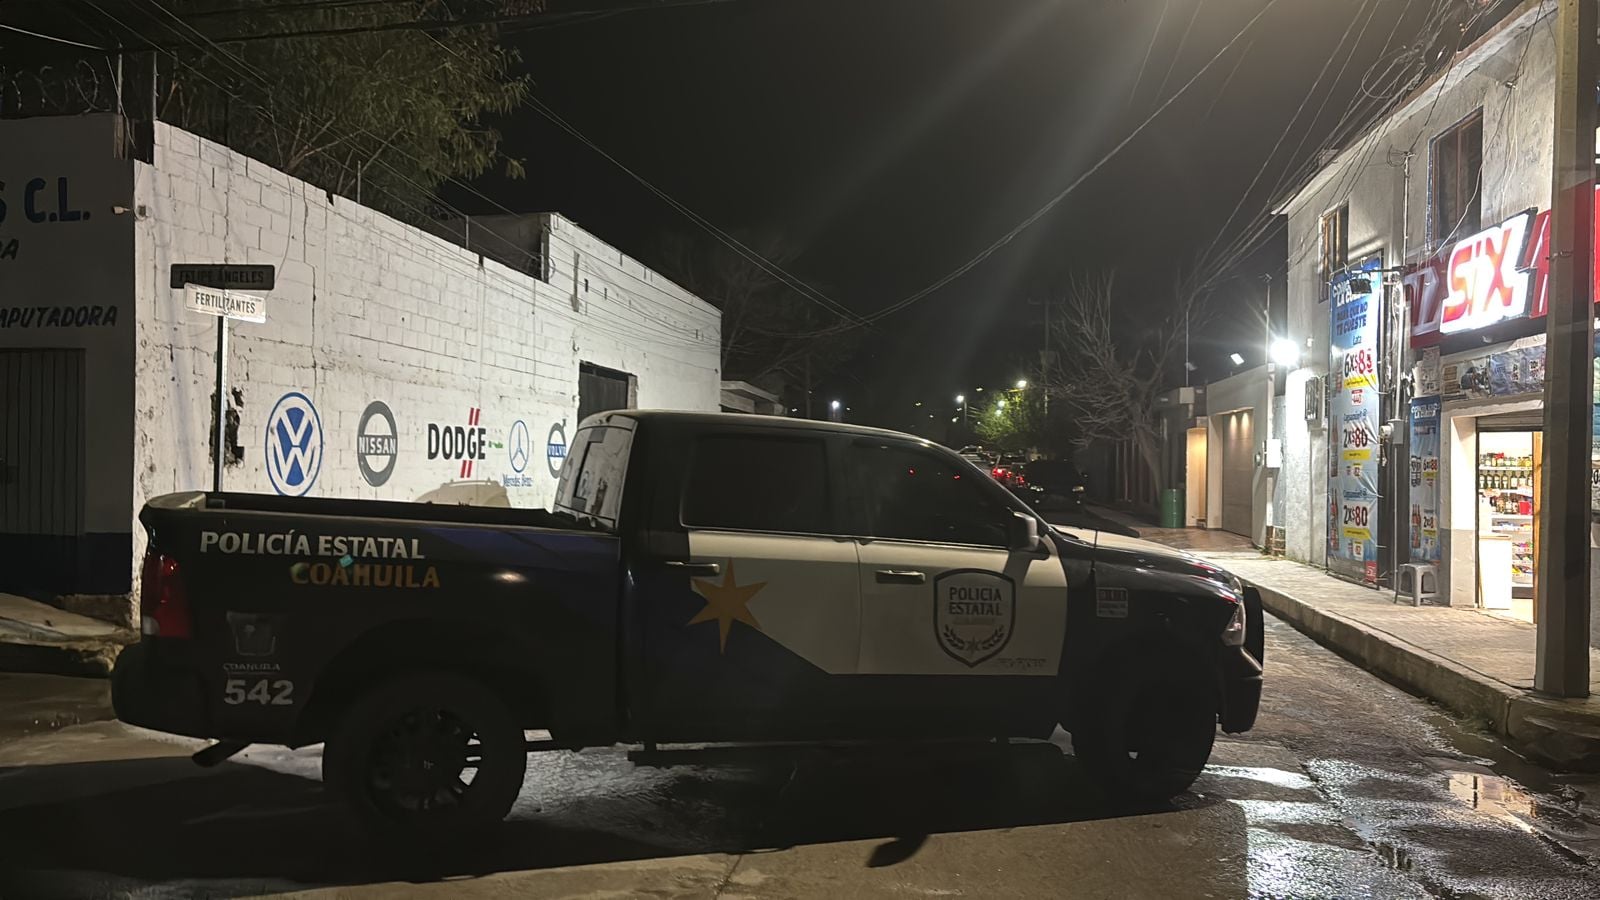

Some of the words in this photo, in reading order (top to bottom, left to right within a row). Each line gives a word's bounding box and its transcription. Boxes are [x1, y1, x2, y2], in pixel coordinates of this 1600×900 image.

[25, 177, 90, 223] C.L.
[0, 239, 19, 260] A
[195, 292, 256, 314] FERTILIZANTES
[359, 437, 397, 456] NISSAN
[427, 423, 487, 460] DODGE
[200, 529, 311, 556] POLICÍA
[318, 535, 425, 559] ESTATAL
[289, 561, 441, 588] COAHUILA
[949, 602, 1002, 616] ESTATAL
[223, 679, 294, 705] 542
